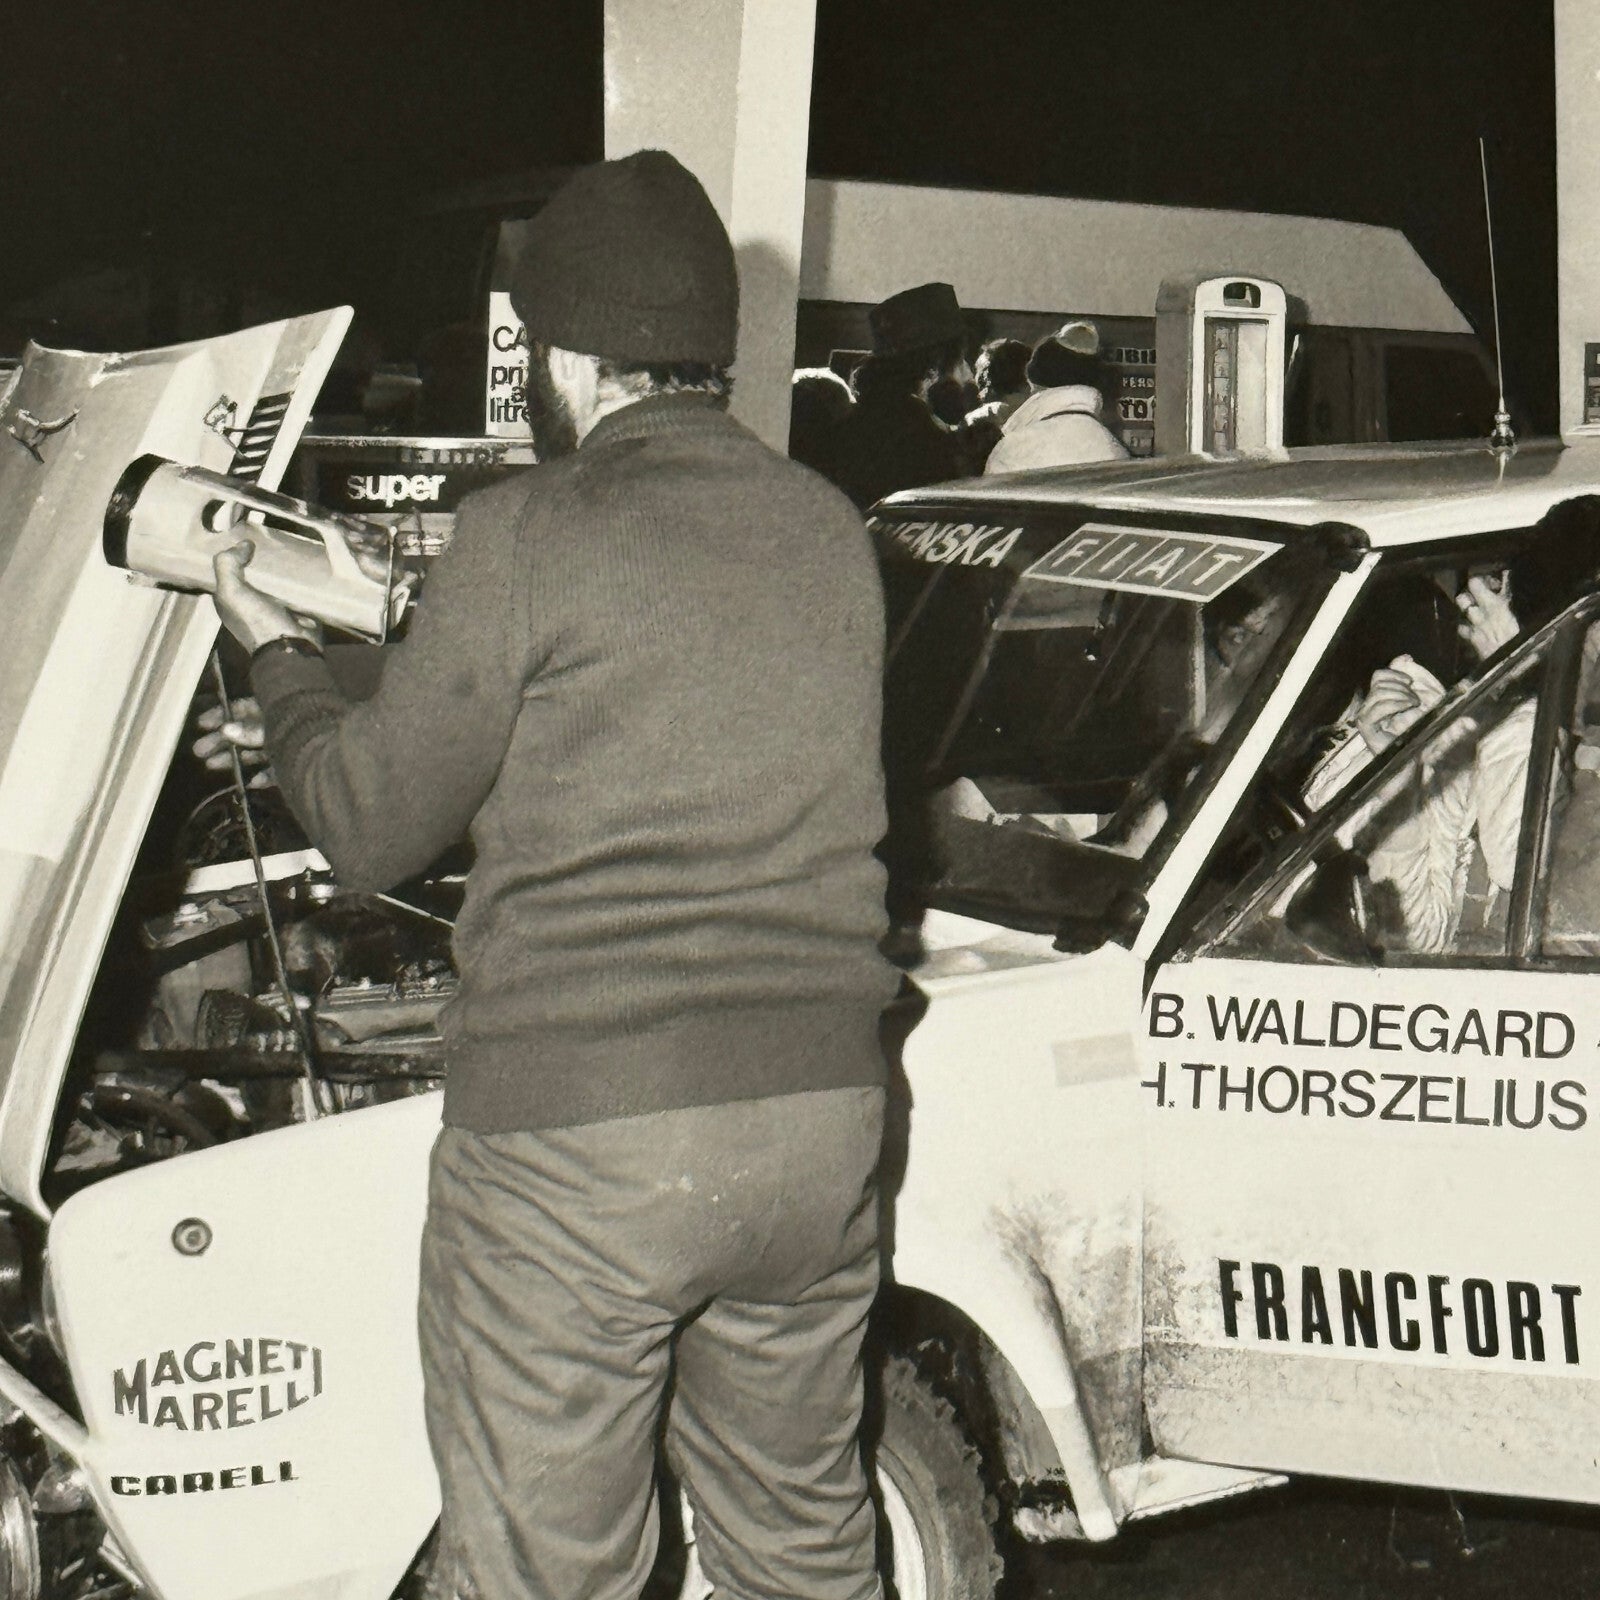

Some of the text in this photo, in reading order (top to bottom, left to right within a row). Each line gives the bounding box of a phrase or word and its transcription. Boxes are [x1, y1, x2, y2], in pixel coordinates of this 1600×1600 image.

[349, 473, 446, 508] super
[1051, 538, 1244, 586] FIAT
[1148, 991, 1576, 1059] B. WALDEGARD
[1218, 1258, 1583, 1365] FRANCFORT
[113, 1337, 323, 1402] MAGNETI
